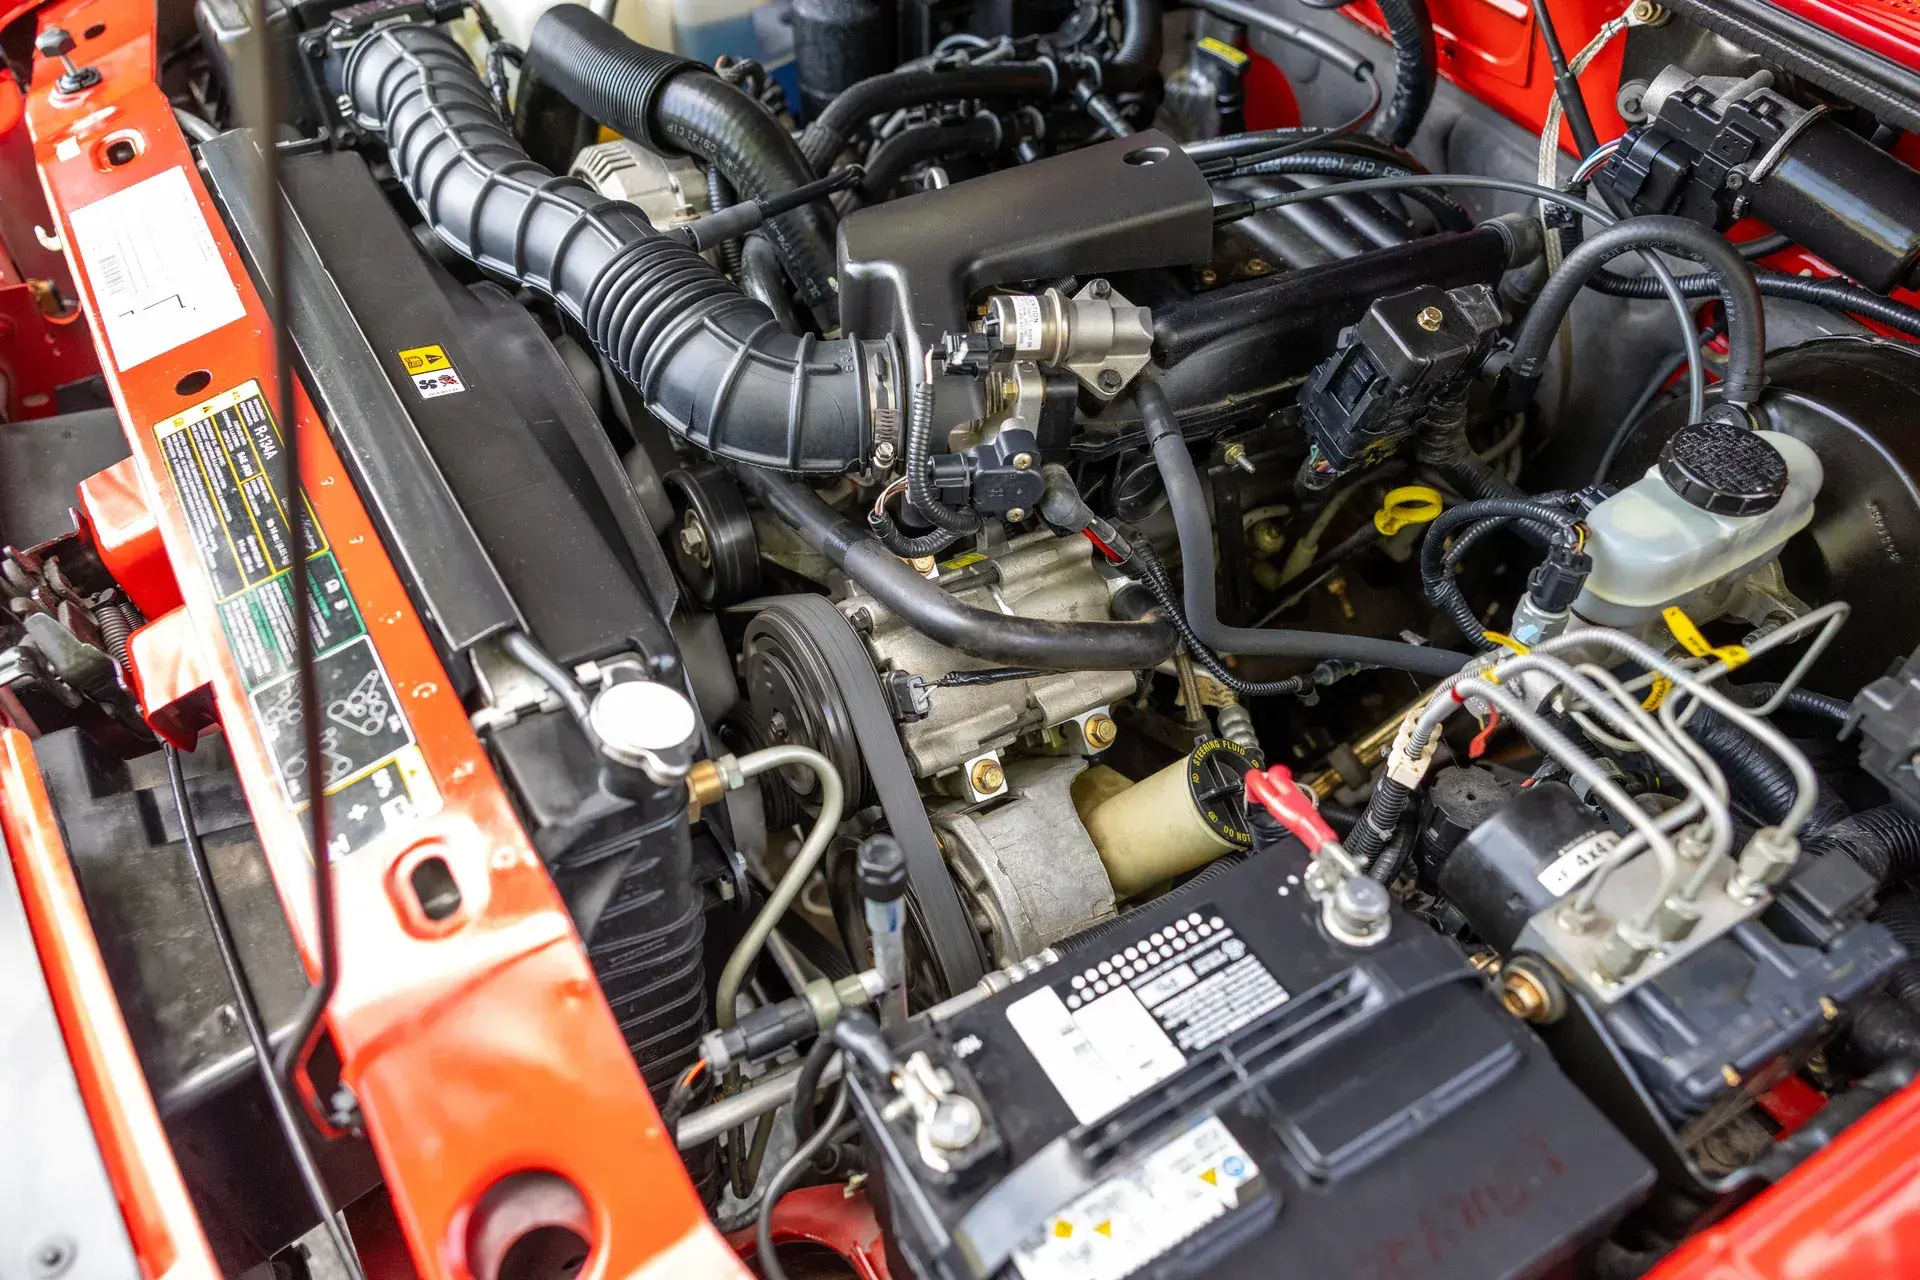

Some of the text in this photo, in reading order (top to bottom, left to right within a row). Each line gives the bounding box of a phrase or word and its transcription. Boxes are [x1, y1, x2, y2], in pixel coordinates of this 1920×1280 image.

[666, 124, 685, 136] CIP
[1352, 160, 1376, 173] CIP
[254, 424, 278, 460] R-134A
[237, 451, 248, 465] SAE
[1193, 740, 1246, 766] STEERING FLUID
[1223, 825, 1252, 843] DO NOT
